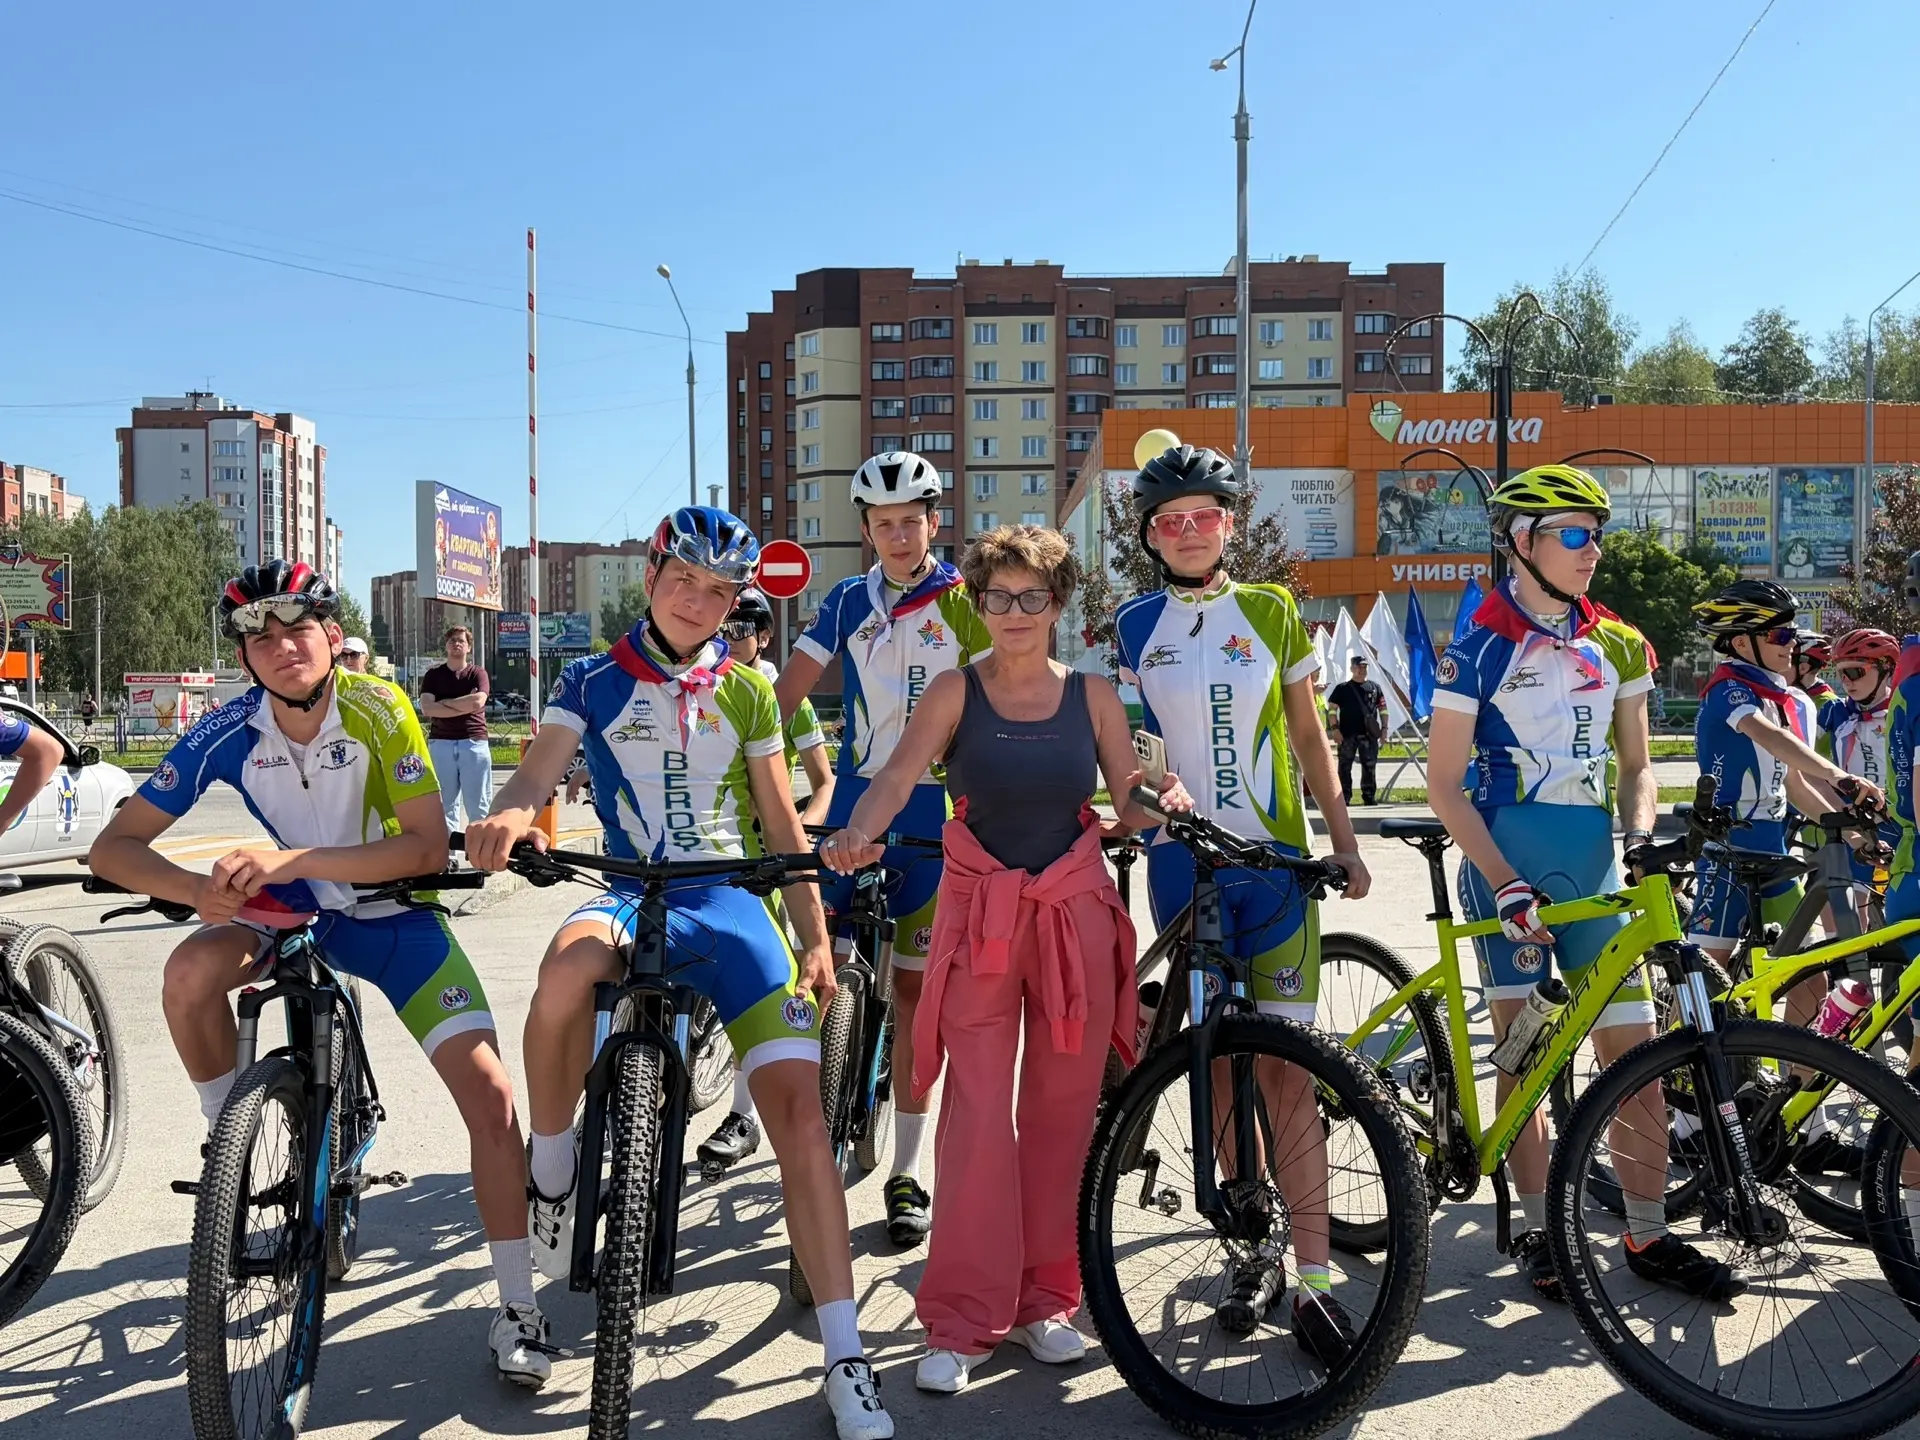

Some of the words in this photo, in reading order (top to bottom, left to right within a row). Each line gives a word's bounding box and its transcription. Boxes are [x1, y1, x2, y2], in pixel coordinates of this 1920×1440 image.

[1291, 479, 1335, 491] ЛЮБЛЮ
[1292, 493, 1336, 505] ЧИТАТЬ
[1701, 516, 1742, 528] товары
[1745, 516, 1766, 528] для
[1708, 500, 1715, 515] 1
[1450, 520, 1491, 538] игрушк
[1737, 531, 1766, 542] ДАЧИ
[1209, 684, 1244, 810] BERDSK
[664, 750, 703, 853] BERDS
[1519, 951, 1603, 1092] FORMAT
[1089, 1109, 1126, 1232] SCHWALBE
[1563, 1181, 1583, 1268] TERRAINS
[1576, 1271, 1599, 1301] ALL
[1589, 1303, 1626, 1345] CST
